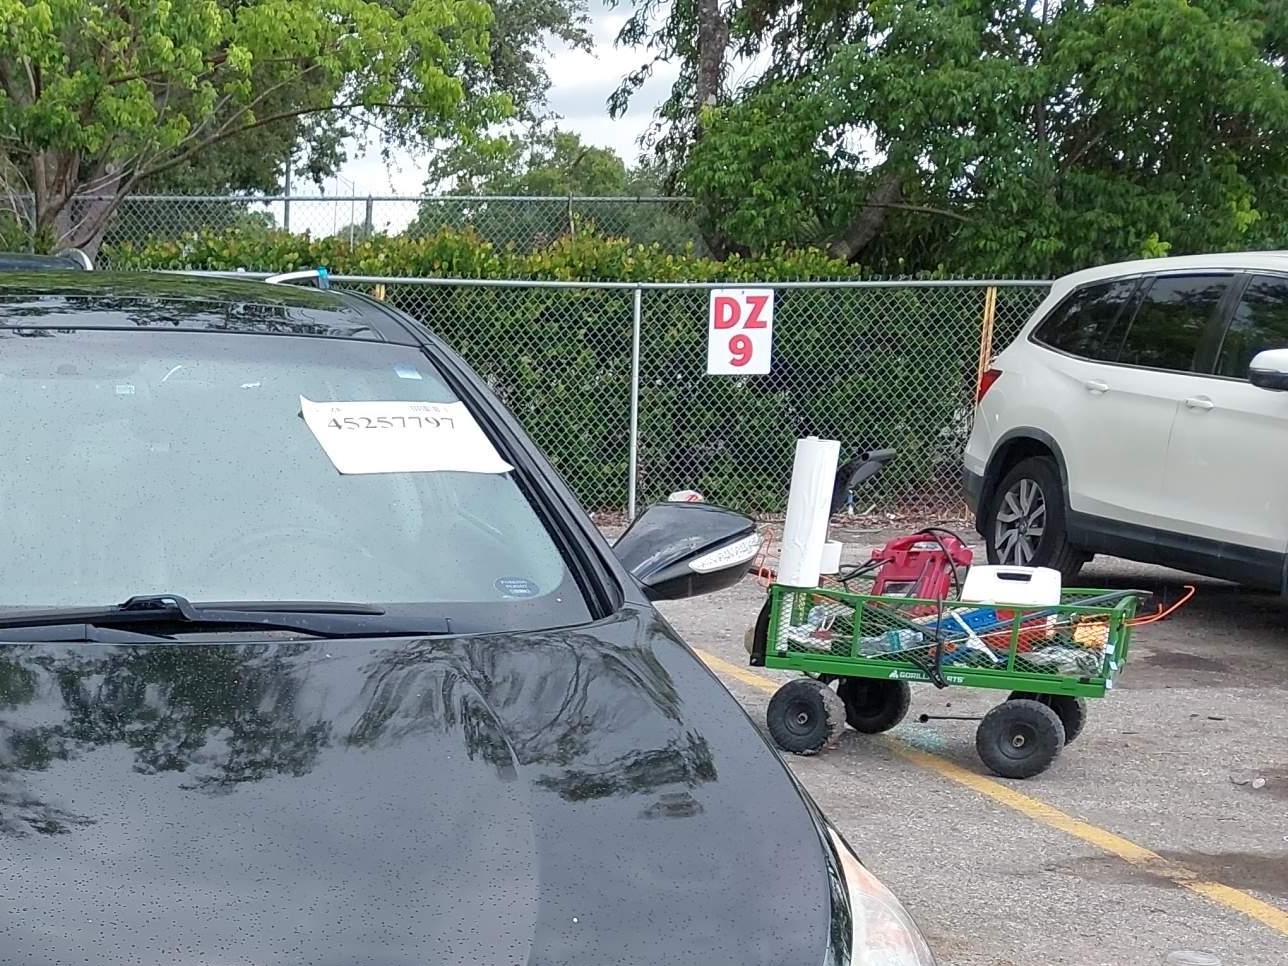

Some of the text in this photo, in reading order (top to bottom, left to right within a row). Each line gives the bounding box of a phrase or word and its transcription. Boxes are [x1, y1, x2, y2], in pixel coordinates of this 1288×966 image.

[714, 296, 769, 330] DZ
[728, 334, 753, 367] 9
[327, 416, 454, 430] 45257797
